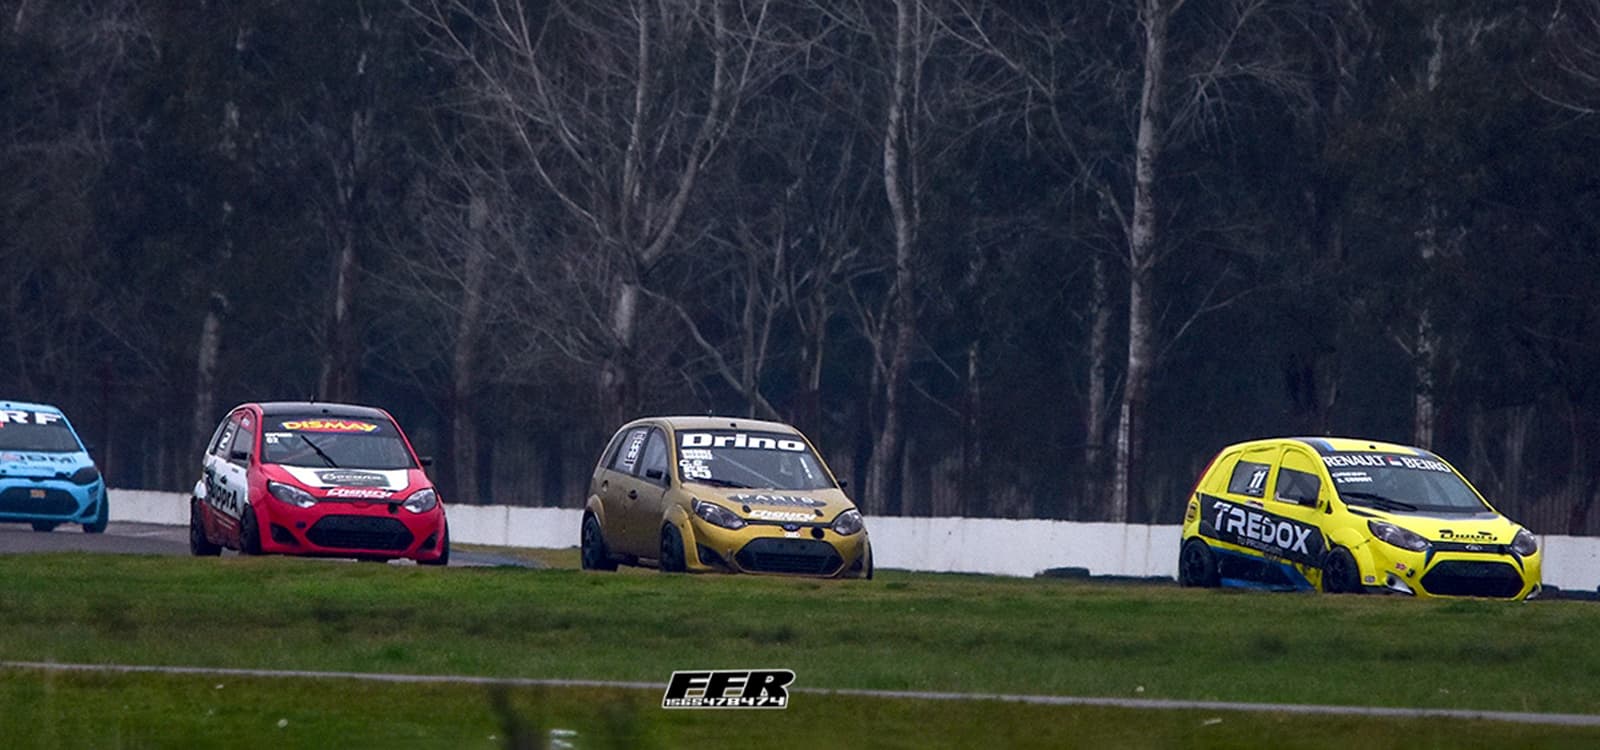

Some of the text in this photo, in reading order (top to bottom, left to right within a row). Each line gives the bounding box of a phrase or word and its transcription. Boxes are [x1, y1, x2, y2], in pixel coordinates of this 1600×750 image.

[281, 419, 378, 432] DISMAY
[682, 433, 806, 451] Drino
[1322, 455, 1452, 472] RENAULT BEIRO
[1249, 470, 1267, 489] 11
[1213, 501, 1312, 555] TREDOX
